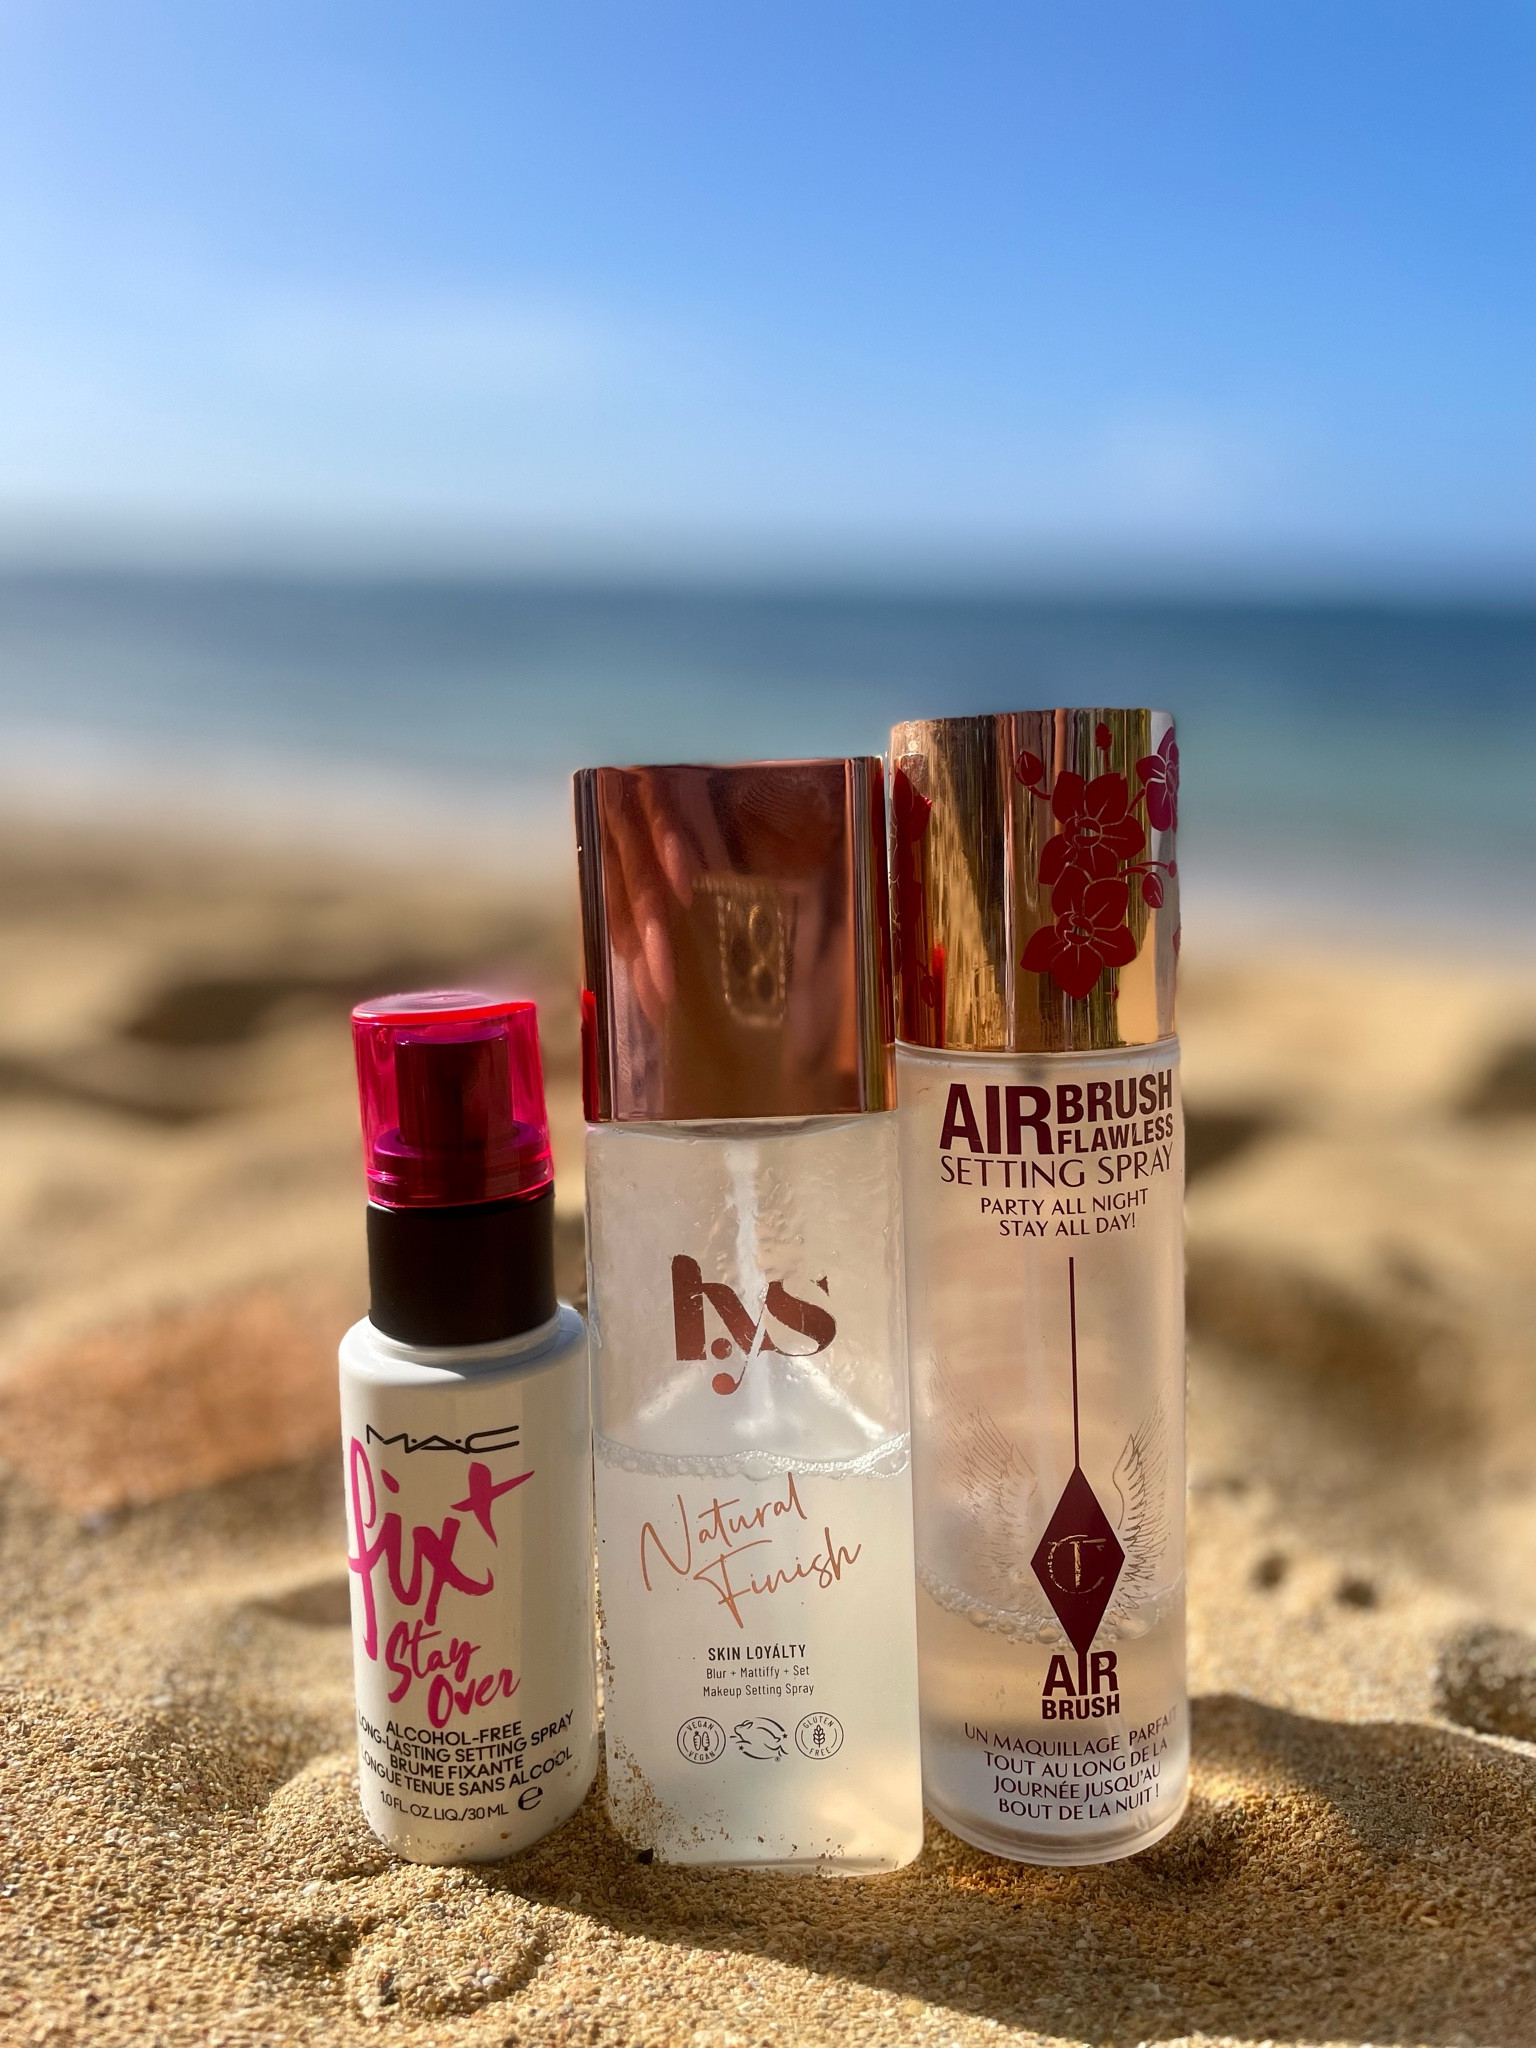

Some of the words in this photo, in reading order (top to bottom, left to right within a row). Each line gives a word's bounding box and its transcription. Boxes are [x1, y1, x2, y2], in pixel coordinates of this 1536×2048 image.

[939, 1083, 1055, 1155] AIR
[1056, 1068, 1172, 1125] BRUSH
[1058, 1113, 1174, 1154] FLAWLESS
[940, 1155, 1086, 1188] SETTING
[1097, 1142, 1173, 1185] SPRAY
[981, 1197, 1045, 1215] PARTY
[1051, 1198, 1087, 1215] ALL
[1092, 1188, 1148, 1212] NIGHT
[1000, 1220, 1048, 1237] STAY
[1055, 1219, 1090, 1236] ALL
[1096, 1212, 1136, 1234] DAY!
[640, 1471, 808, 1591] Natural
[693, 1526, 862, 1629] Finish
[385, 1619, 481, 1703] Stay
[708, 1646, 741, 1661] SKIN
[746, 1643, 806, 1660] LOYÁLTY
[706, 1668, 726, 1679] Blur
[740, 1666, 780, 1679] Mattiffy
[793, 1665, 810, 1676] Set
[1042, 1650, 1119, 1697] AIR
[427, 1668, 521, 1729] Over
[703, 1686, 742, 1698] Makeup
[745, 1684, 782, 1697] Setting
[785, 1683, 815, 1696] Spray
[1041, 1694, 1120, 1720] BRUSH
[358, 1709, 451, 1763] LONG-LASTING
[455, 1737, 527, 1762] SETTING
[531, 1708, 574, 1746] SPRAY
[386, 1720, 522, 1746] ALCOHOL-FREE
[686, 1720, 715, 1732] VEGAN
[802, 1716, 835, 1729] GLUTEN
[808, 1747, 831, 1757] FREE
[964, 1722, 989, 1744] UN
[993, 1735, 1120, 1757] MAQUILLAGE
[390, 1754, 444, 1779] BRUME
[448, 1754, 524, 1779] FIXANTE
[688, 1751, 716, 1761] VEGAN
[984, 1751, 1036, 1776] TOUT
[1041, 1761, 1068, 1778] AU
[1073, 1755, 1126, 1778] LONG
[1131, 1745, 1150, 1767] DE
[1153, 1737, 1168, 1757] LA
[361, 1744, 403, 1788] LONGUE
[404, 1775, 455, 1796] TENUE
[459, 1777, 505, 1796] SANS
[509, 1747, 573, 1789] ALCOOL
[993, 1775, 1080, 1799] JOURNÉE
[488, 1803, 509, 1818] ML
[999, 1798, 1053, 1820] BOUT
[1059, 1805, 1083, 1820] DE
[1089, 1802, 1111, 1819] LA
